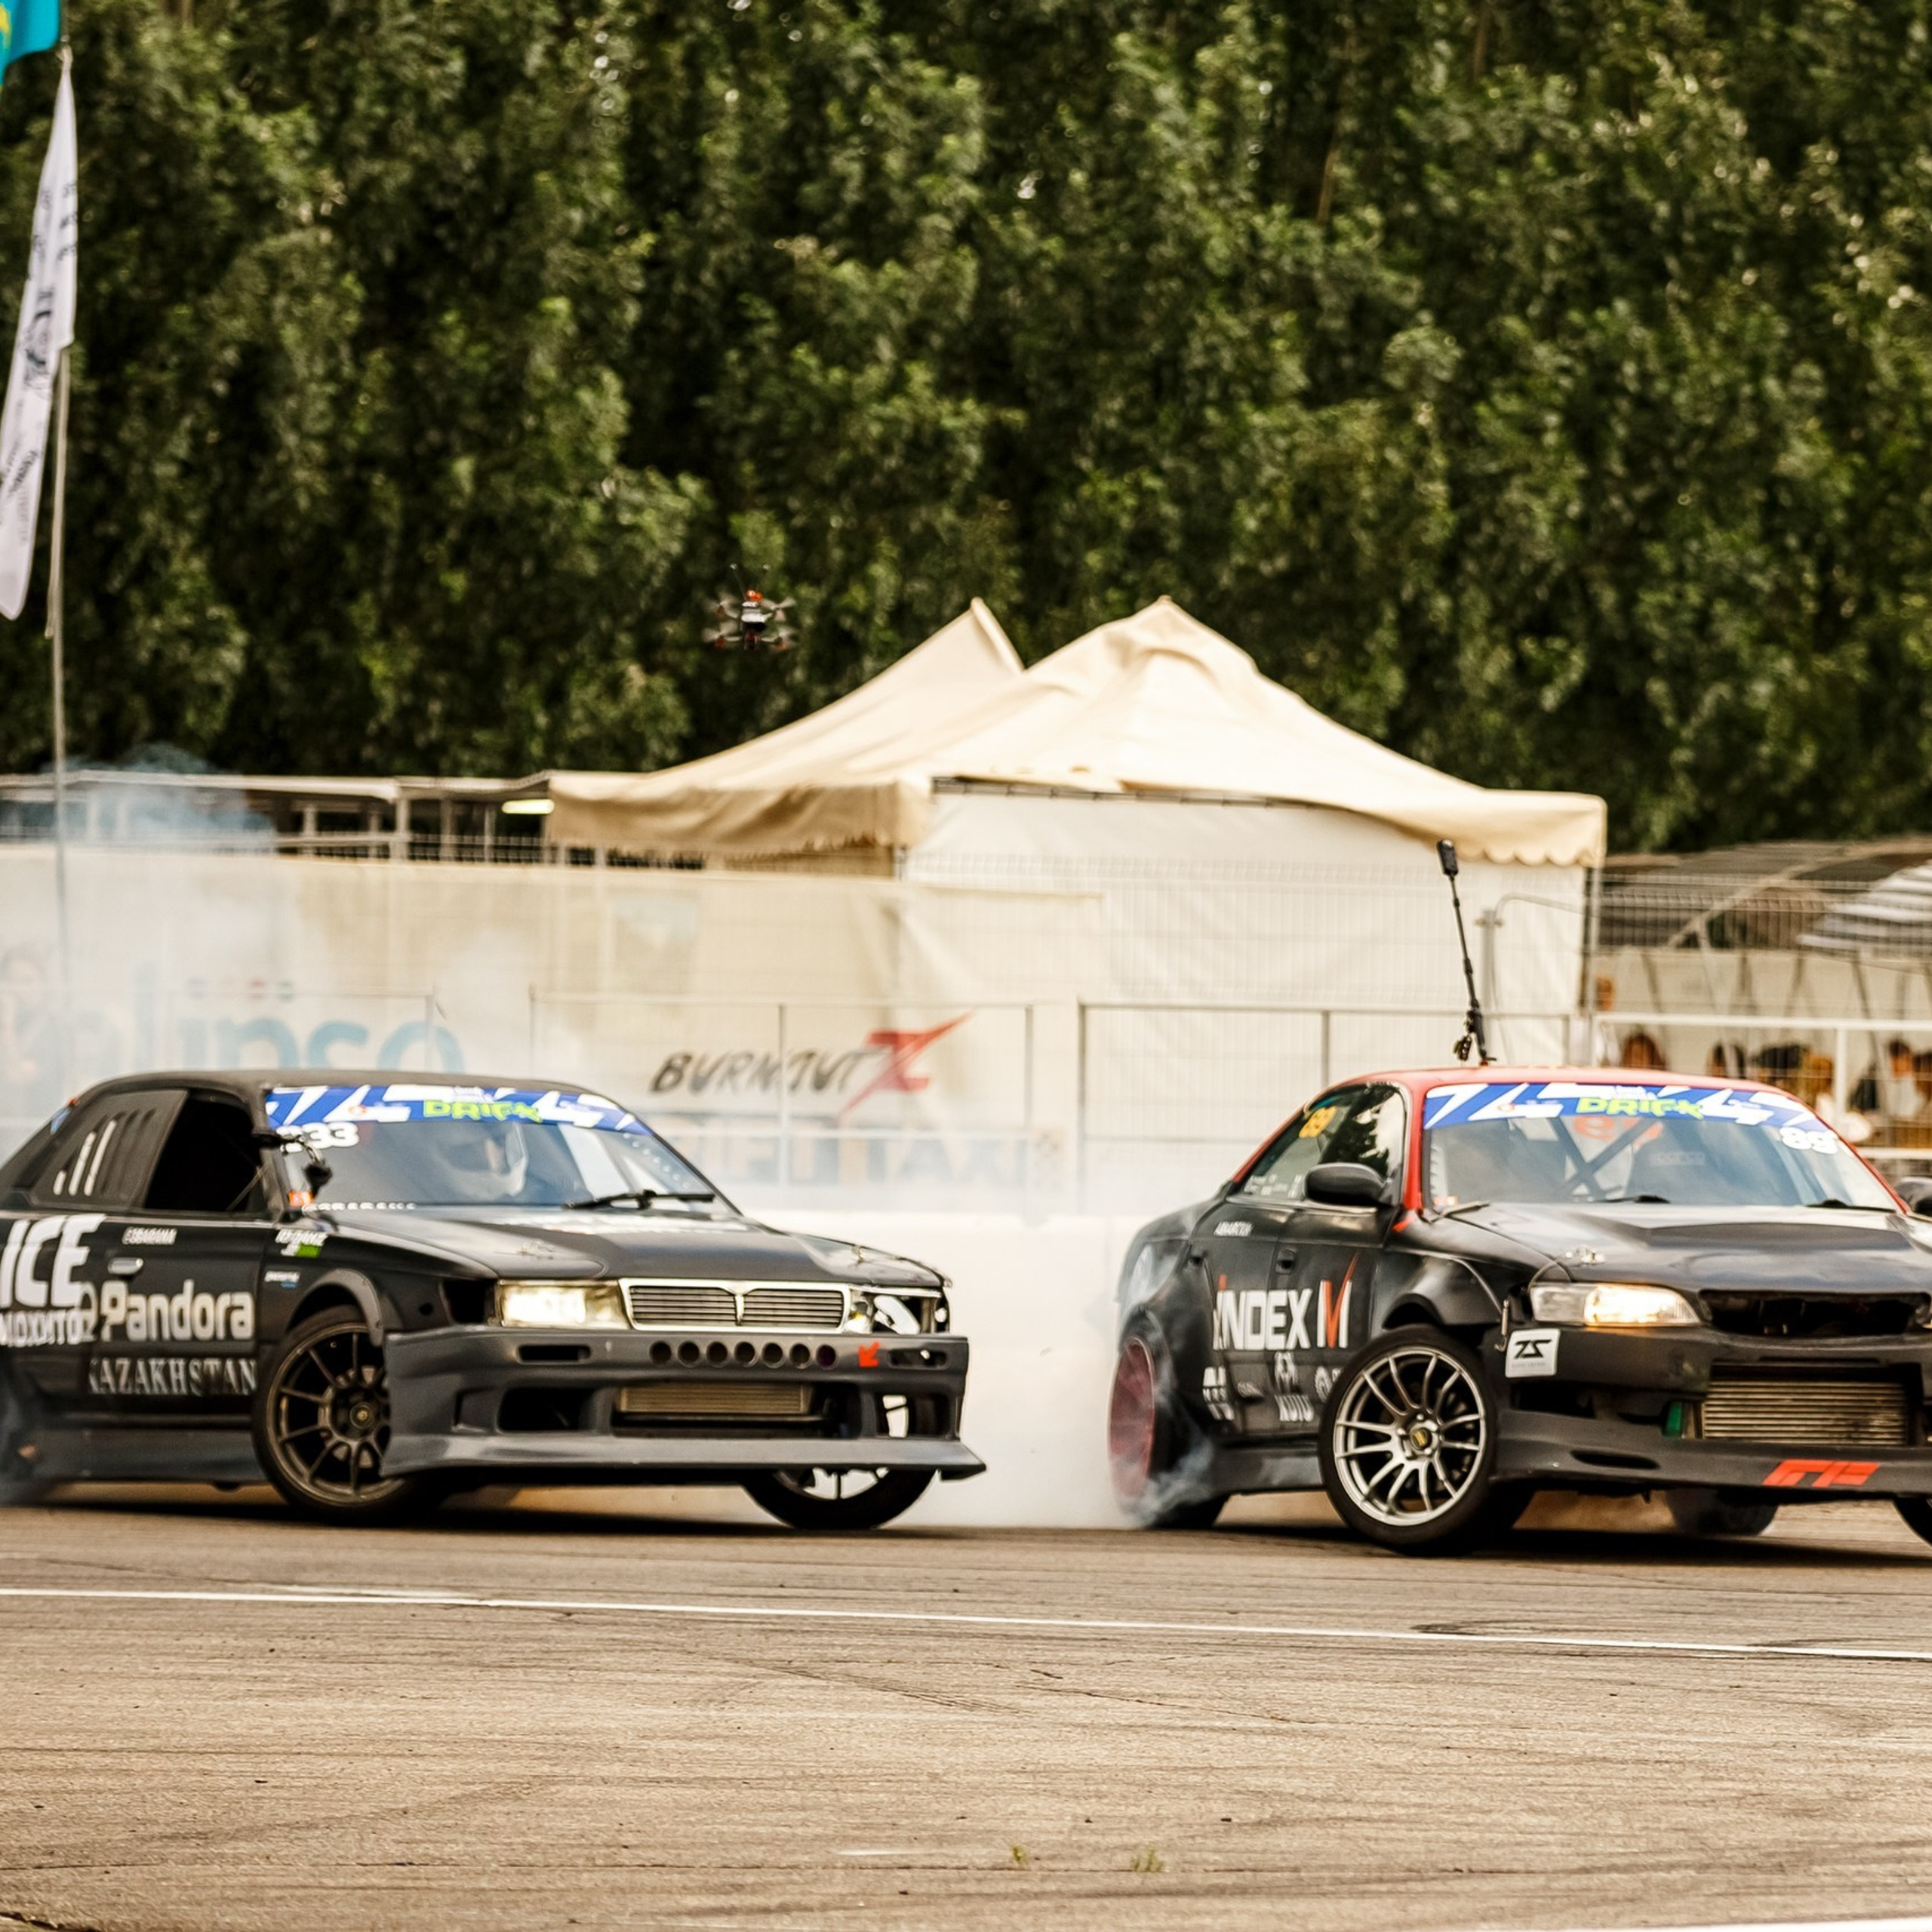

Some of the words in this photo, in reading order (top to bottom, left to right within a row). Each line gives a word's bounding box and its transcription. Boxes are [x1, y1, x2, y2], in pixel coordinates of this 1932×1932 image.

[100, 1279, 255, 1342] Pandora
[1212, 1274, 1313, 1350] INDEX
[88, 1358, 258, 1396] KAZAKHSTAN
